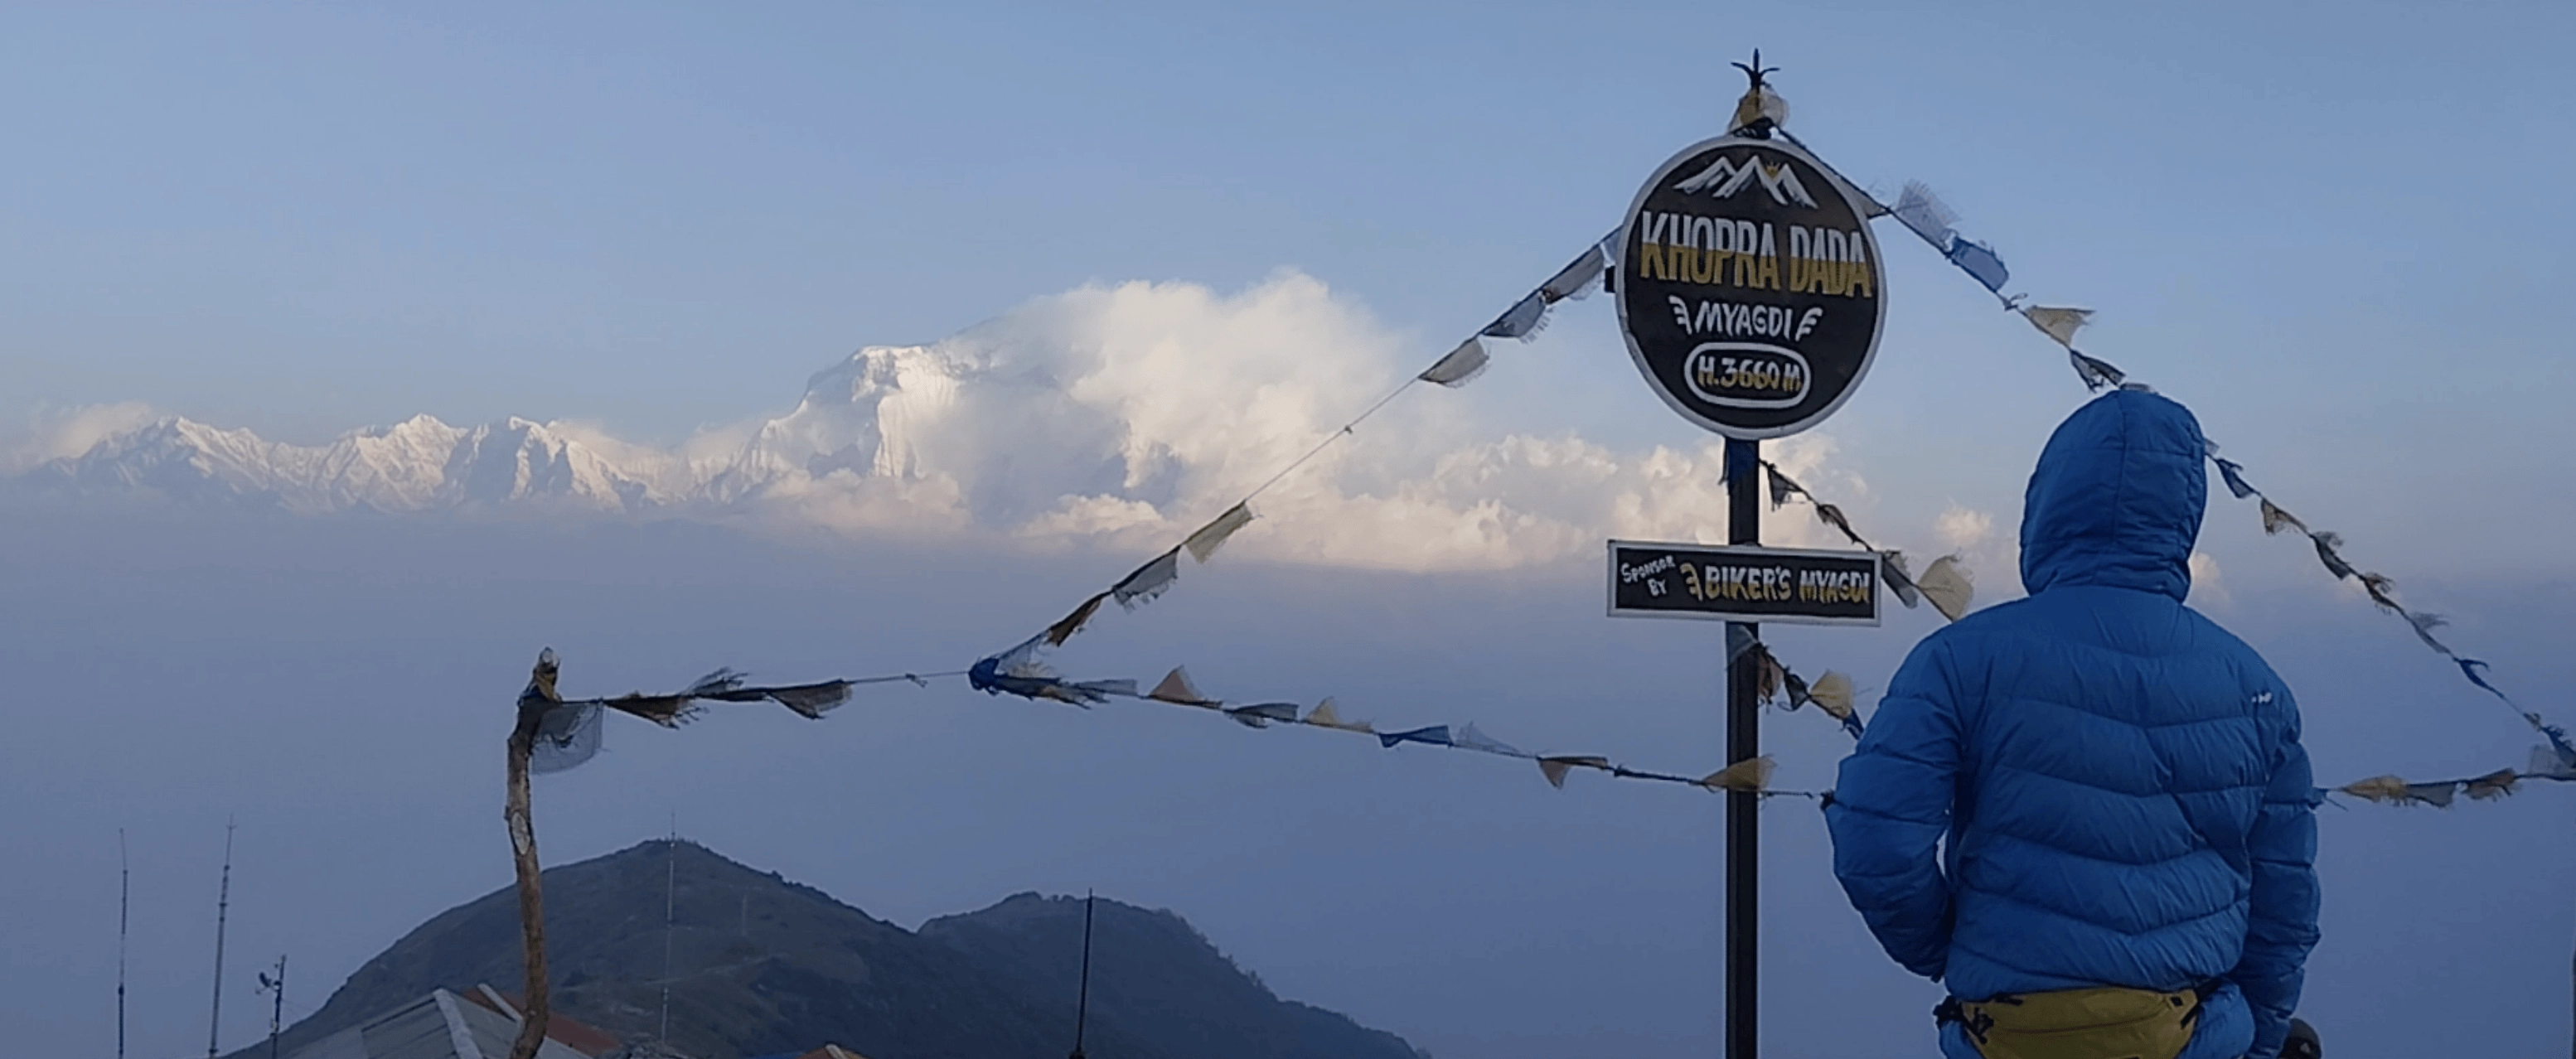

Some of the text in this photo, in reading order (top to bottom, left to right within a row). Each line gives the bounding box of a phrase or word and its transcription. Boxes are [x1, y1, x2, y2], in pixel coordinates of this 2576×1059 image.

[1639, 210, 1872, 298] KHOPRA DADA
[1695, 300, 1793, 337] MYAGDI
[1648, 579, 1668, 597] BY
[1705, 565, 1870, 605] BIKER'S MYAGDI
